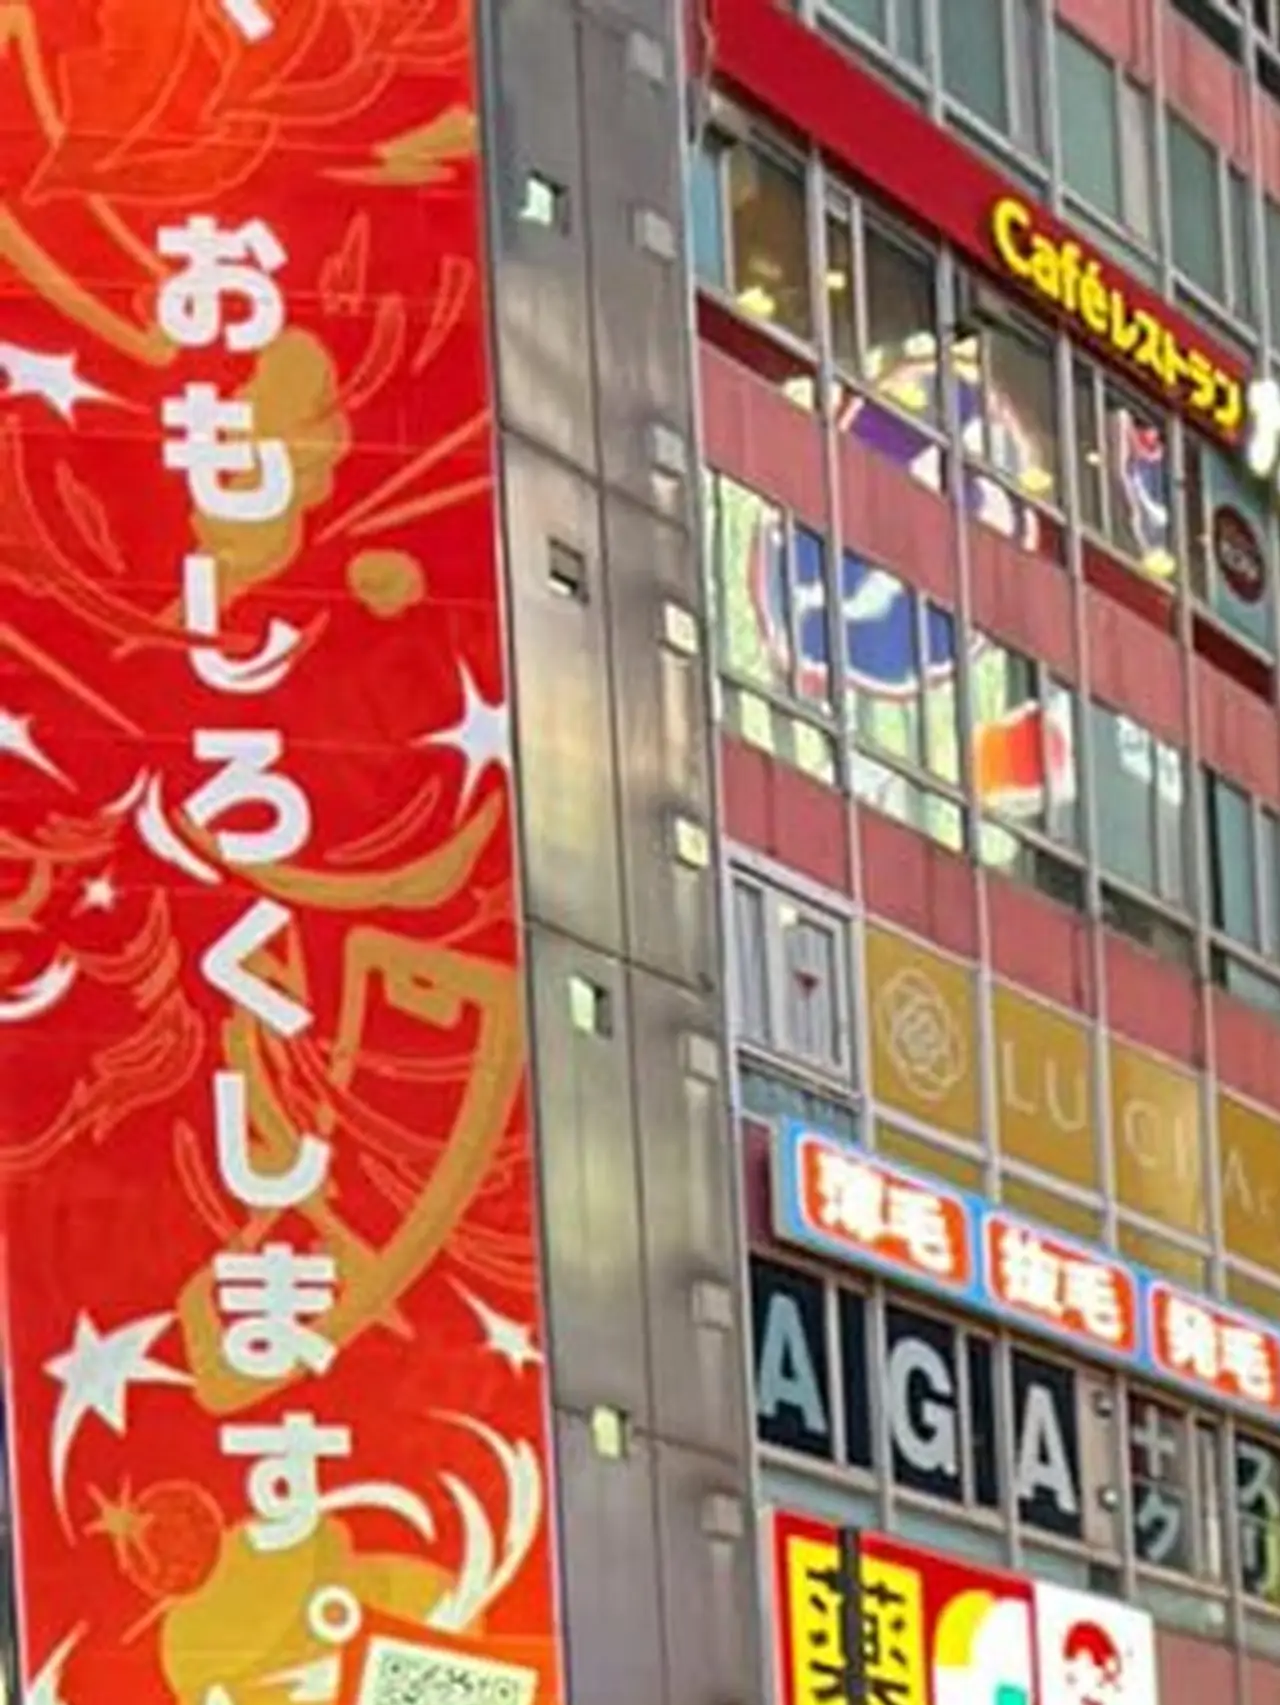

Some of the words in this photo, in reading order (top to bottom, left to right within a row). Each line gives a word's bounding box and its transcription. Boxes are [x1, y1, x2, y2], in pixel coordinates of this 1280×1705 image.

[156, 215, 361, 1643] おもしろくします。
[757, 1290, 1080, 1516] AGA
